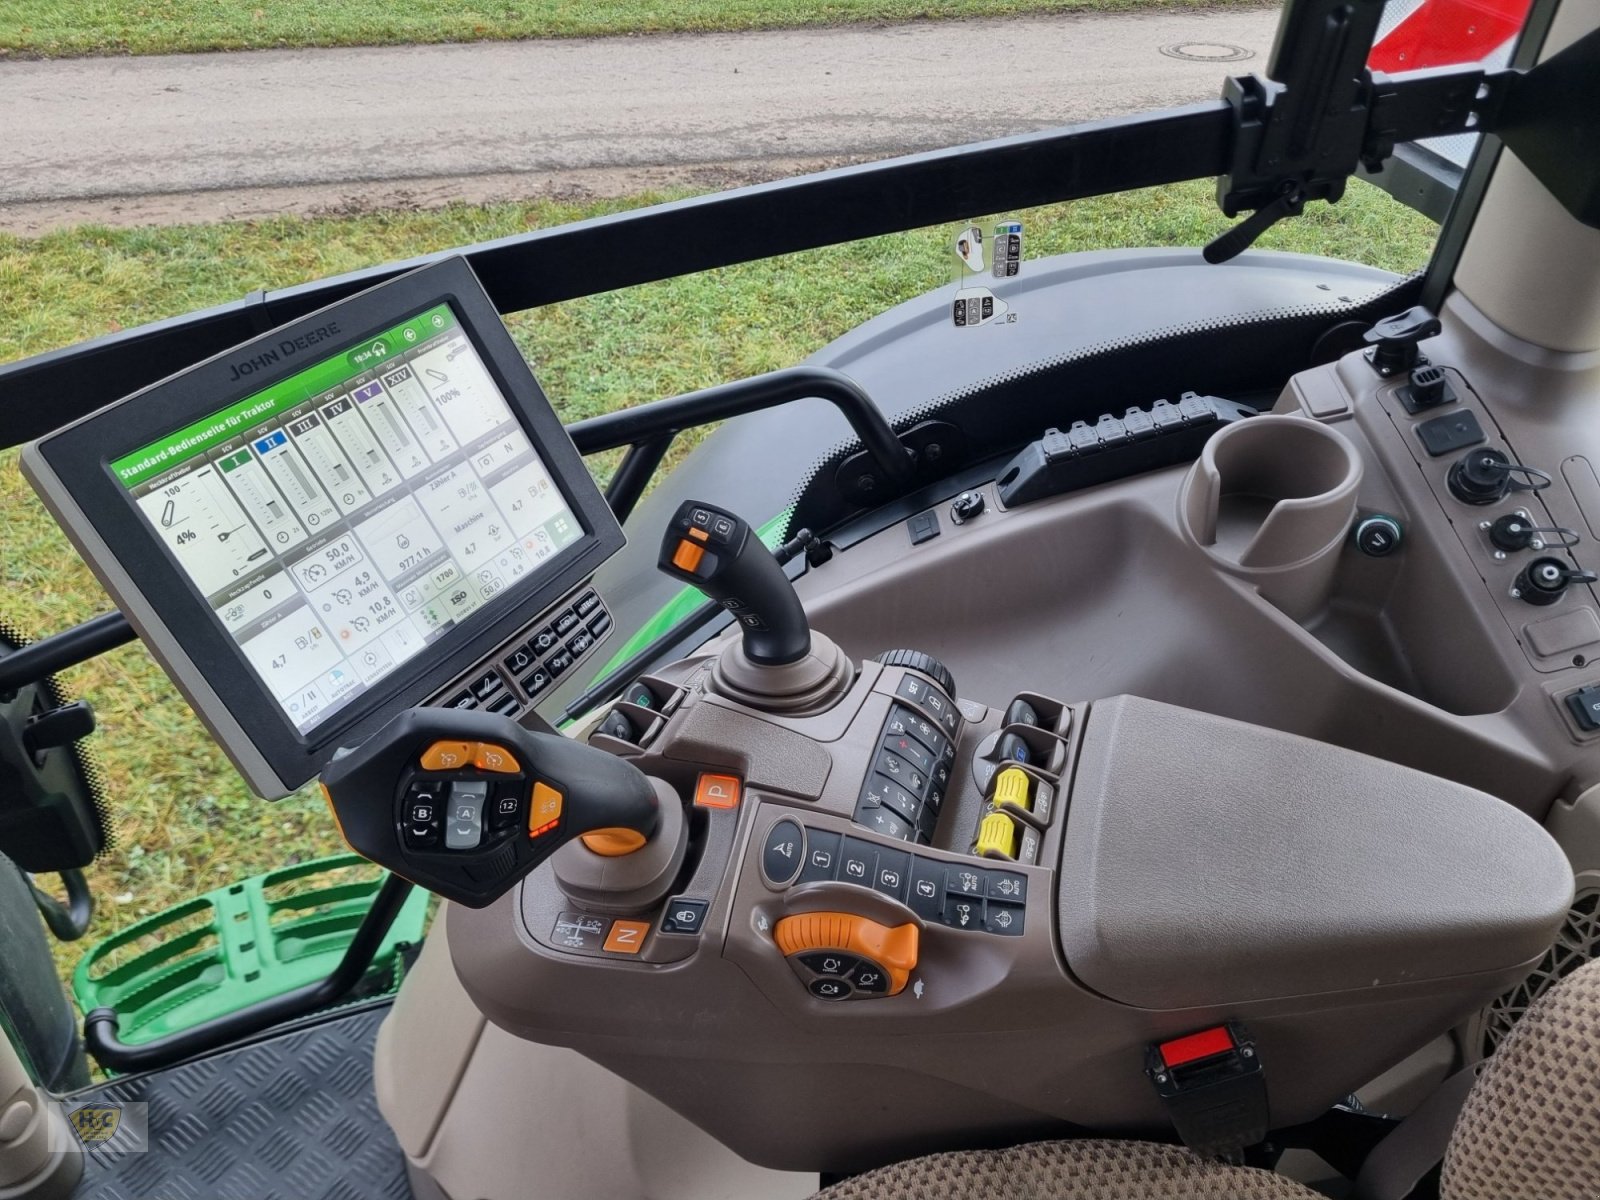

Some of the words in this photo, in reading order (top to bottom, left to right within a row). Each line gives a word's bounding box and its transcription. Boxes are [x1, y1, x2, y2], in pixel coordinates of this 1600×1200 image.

[230, 352, 280, 382] JOHN
[284, 322, 342, 356] DEERE
[387, 369, 407, 385] XIV
[362, 387, 372, 397] V
[435, 388, 460, 405] 100%
[329, 402, 343, 415] IV
[296, 418, 313, 432] III
[119, 423, 226, 478] Standard-Bedienseite
[224, 414, 241, 427] für
[240, 398, 275, 419] Traktor
[264, 437, 277, 448] II
[503, 442, 513, 452] N
[231, 456, 240, 465] I
[164, 485, 180, 497] 100
[511, 499, 523, 511] 4,7
[175, 528, 196, 545] 4%
[325, 542, 349, 561] 50,0
[464, 542, 476, 555] 4,7
[334, 554, 354, 570] KM/H
[398, 551, 422, 570] 977,1
[422, 546, 430, 555] h
[354, 571, 370, 586] 4,9
[436, 568, 453, 582] 1700
[262, 589, 272, 599] 0
[358, 581, 379, 597] KM/H
[483, 581, 500, 596] 50,0
[450, 590, 467, 605] ISO
[368, 596, 391, 614] 10,8
[376, 607, 396, 624] KM/H
[271, 653, 287, 669] 4,7
[708, 785, 728, 798] P
[418, 809, 428, 818] B
[462, 810, 470, 818] A
[816, 854, 826, 864] 1
[850, 863, 862, 874] 2
[884, 874, 896, 884] 3
[920, 884, 932, 895] 4
[616, 929, 636, 943] N
